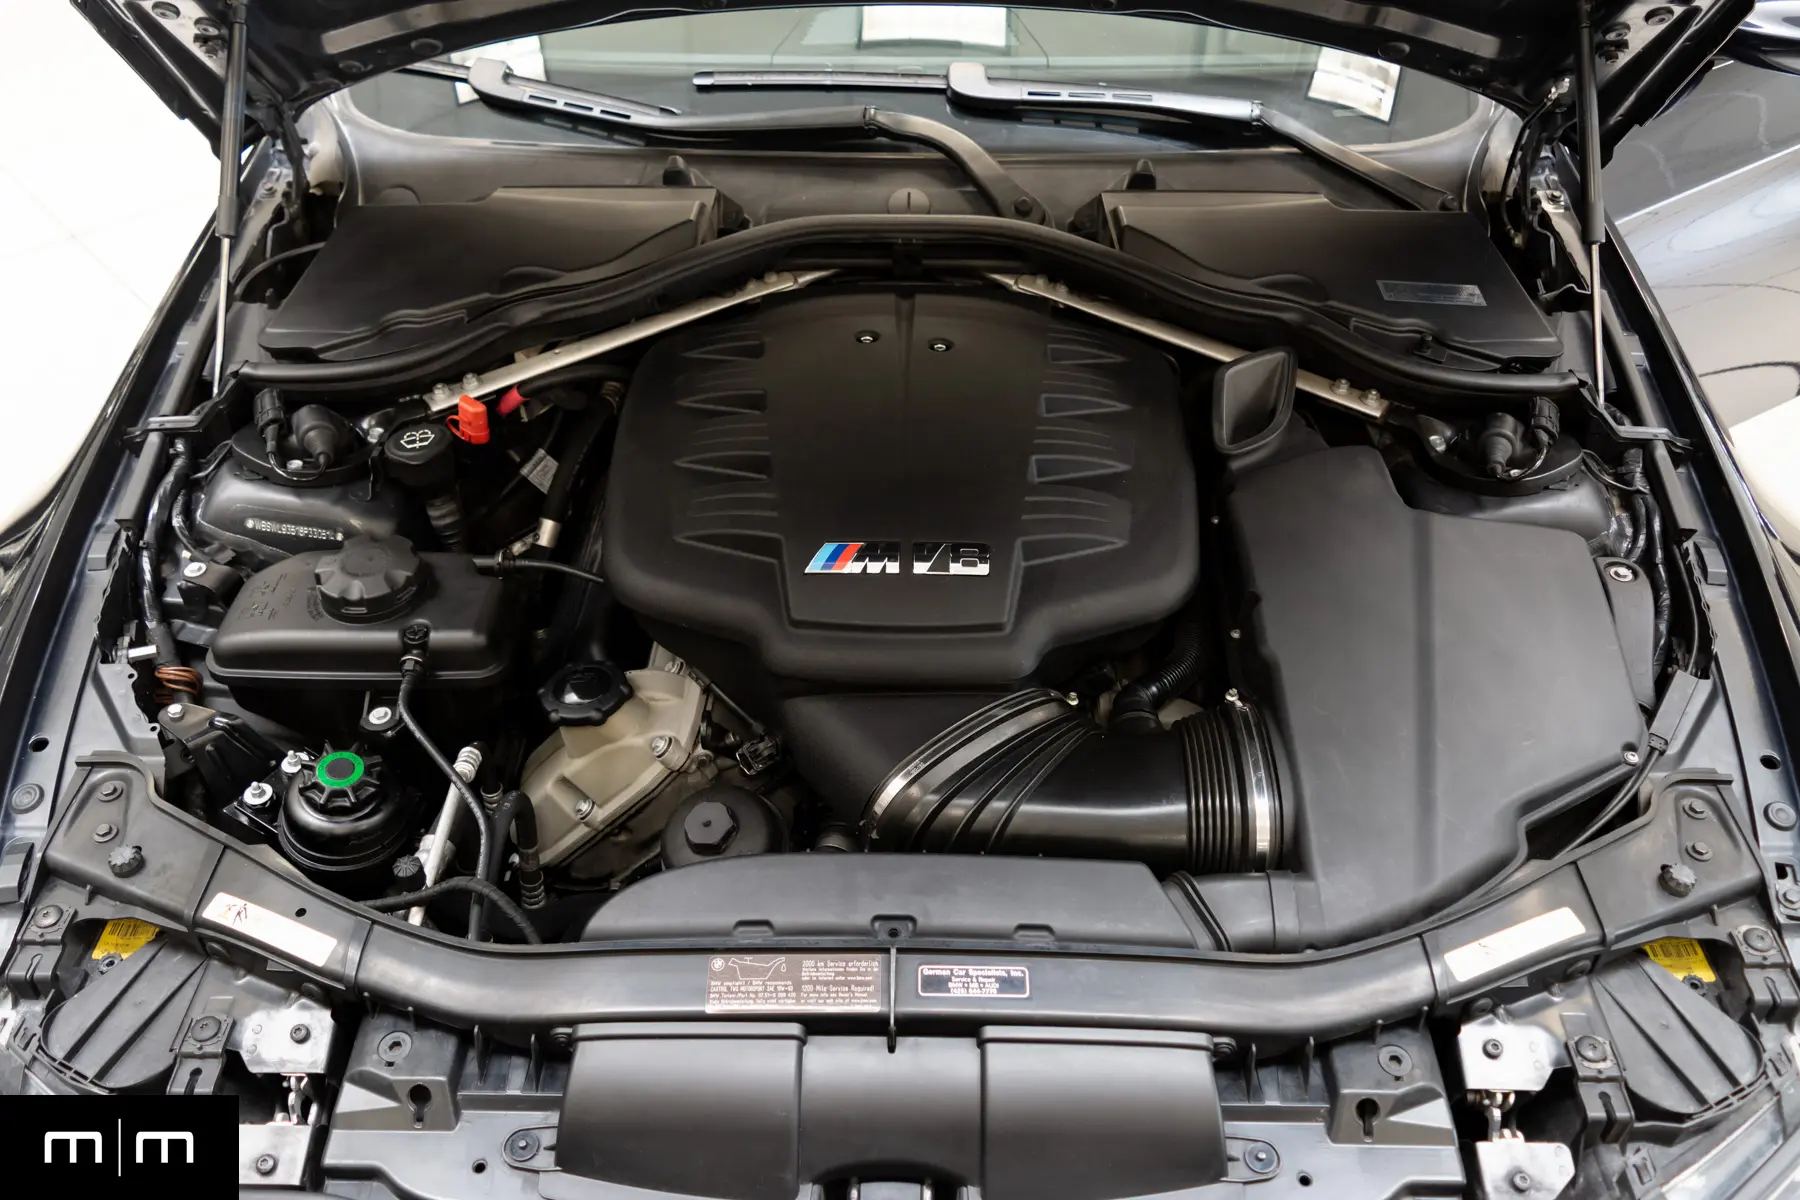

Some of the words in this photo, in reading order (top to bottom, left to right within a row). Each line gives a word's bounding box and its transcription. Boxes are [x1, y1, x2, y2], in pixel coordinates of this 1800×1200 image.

[843, 541, 900, 574] M
[913, 542, 990, 575] V8
[923, 968, 950, 976] German
[953, 968, 966, 976] Car
[968, 968, 1008, 977] Specialists,
[1010, 968, 1024, 976] Inc.
